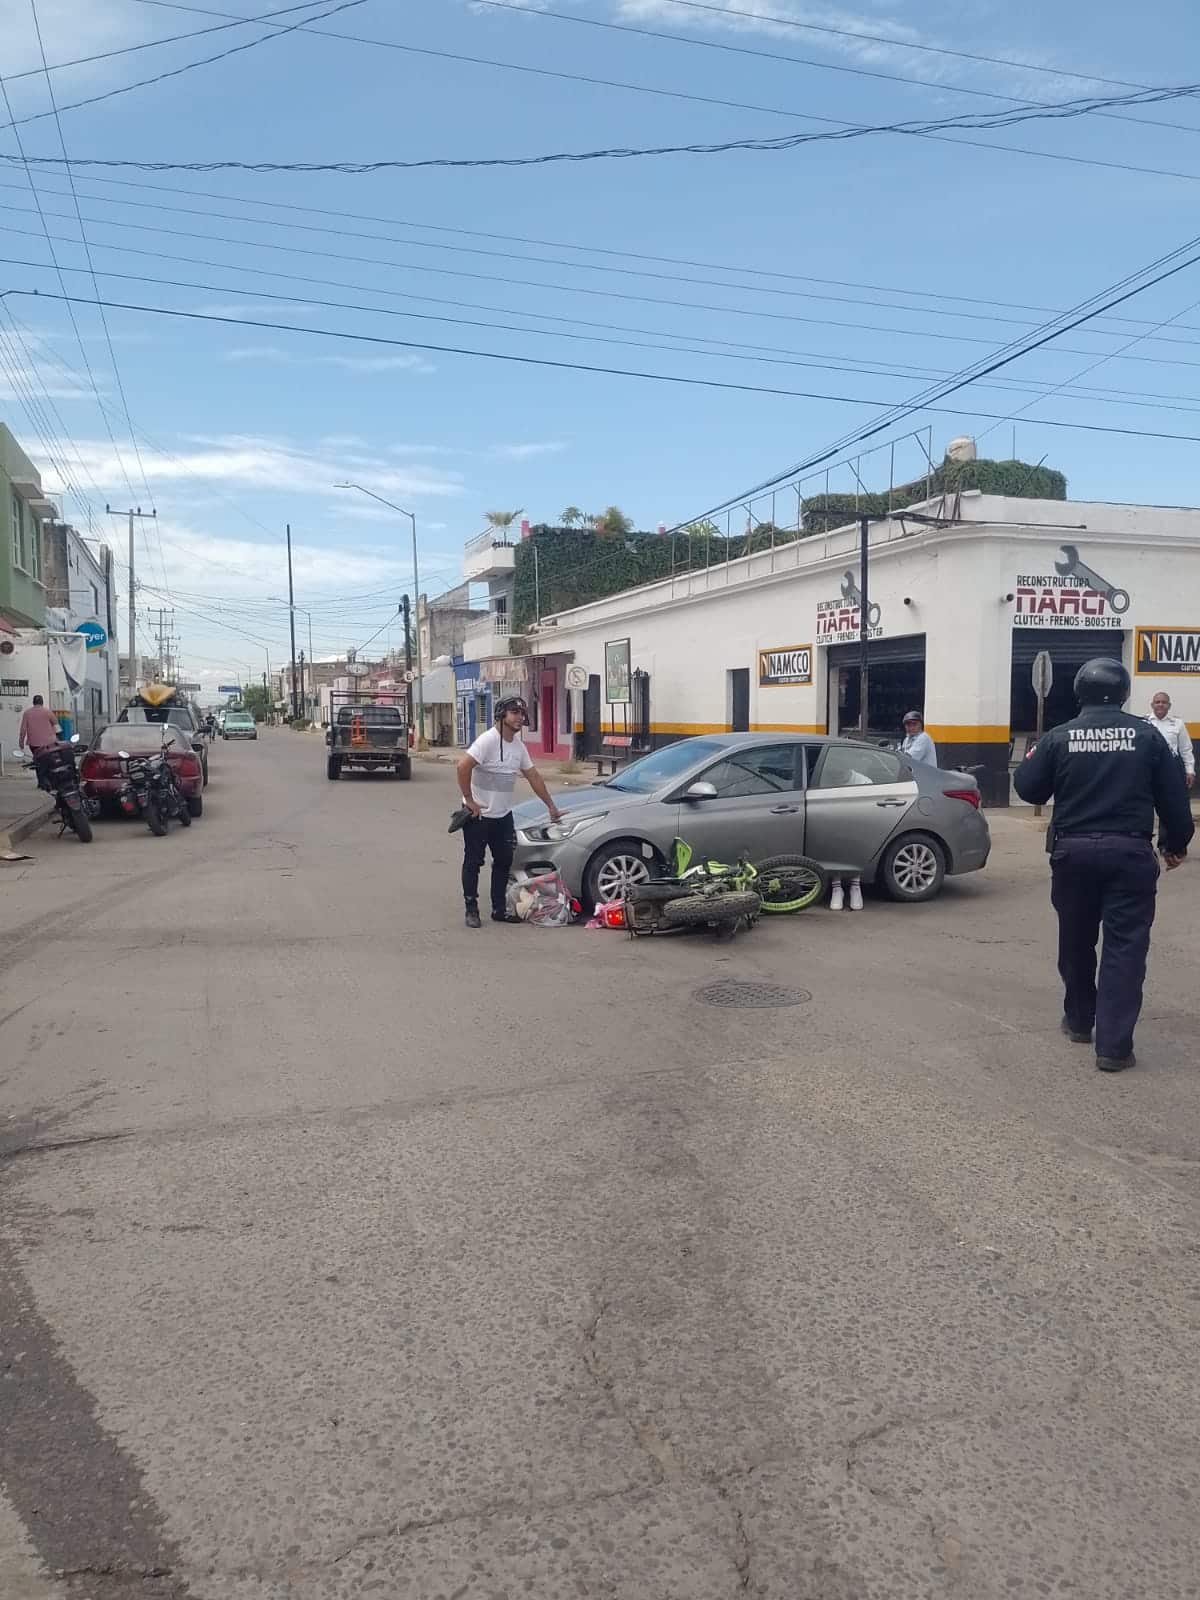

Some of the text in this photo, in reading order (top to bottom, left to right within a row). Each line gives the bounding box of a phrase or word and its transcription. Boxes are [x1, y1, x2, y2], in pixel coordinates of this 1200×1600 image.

[1017, 575, 1090, 588] RECONSTRUCTORA
[1014, 614, 1121, 627] CLUTCH FRENOS BOOSTER
[770, 652, 808, 676] NAMCCO
[1068, 727, 1136, 740] TRANSITO
[1068, 739, 1136, 753] MUNICIPAL
